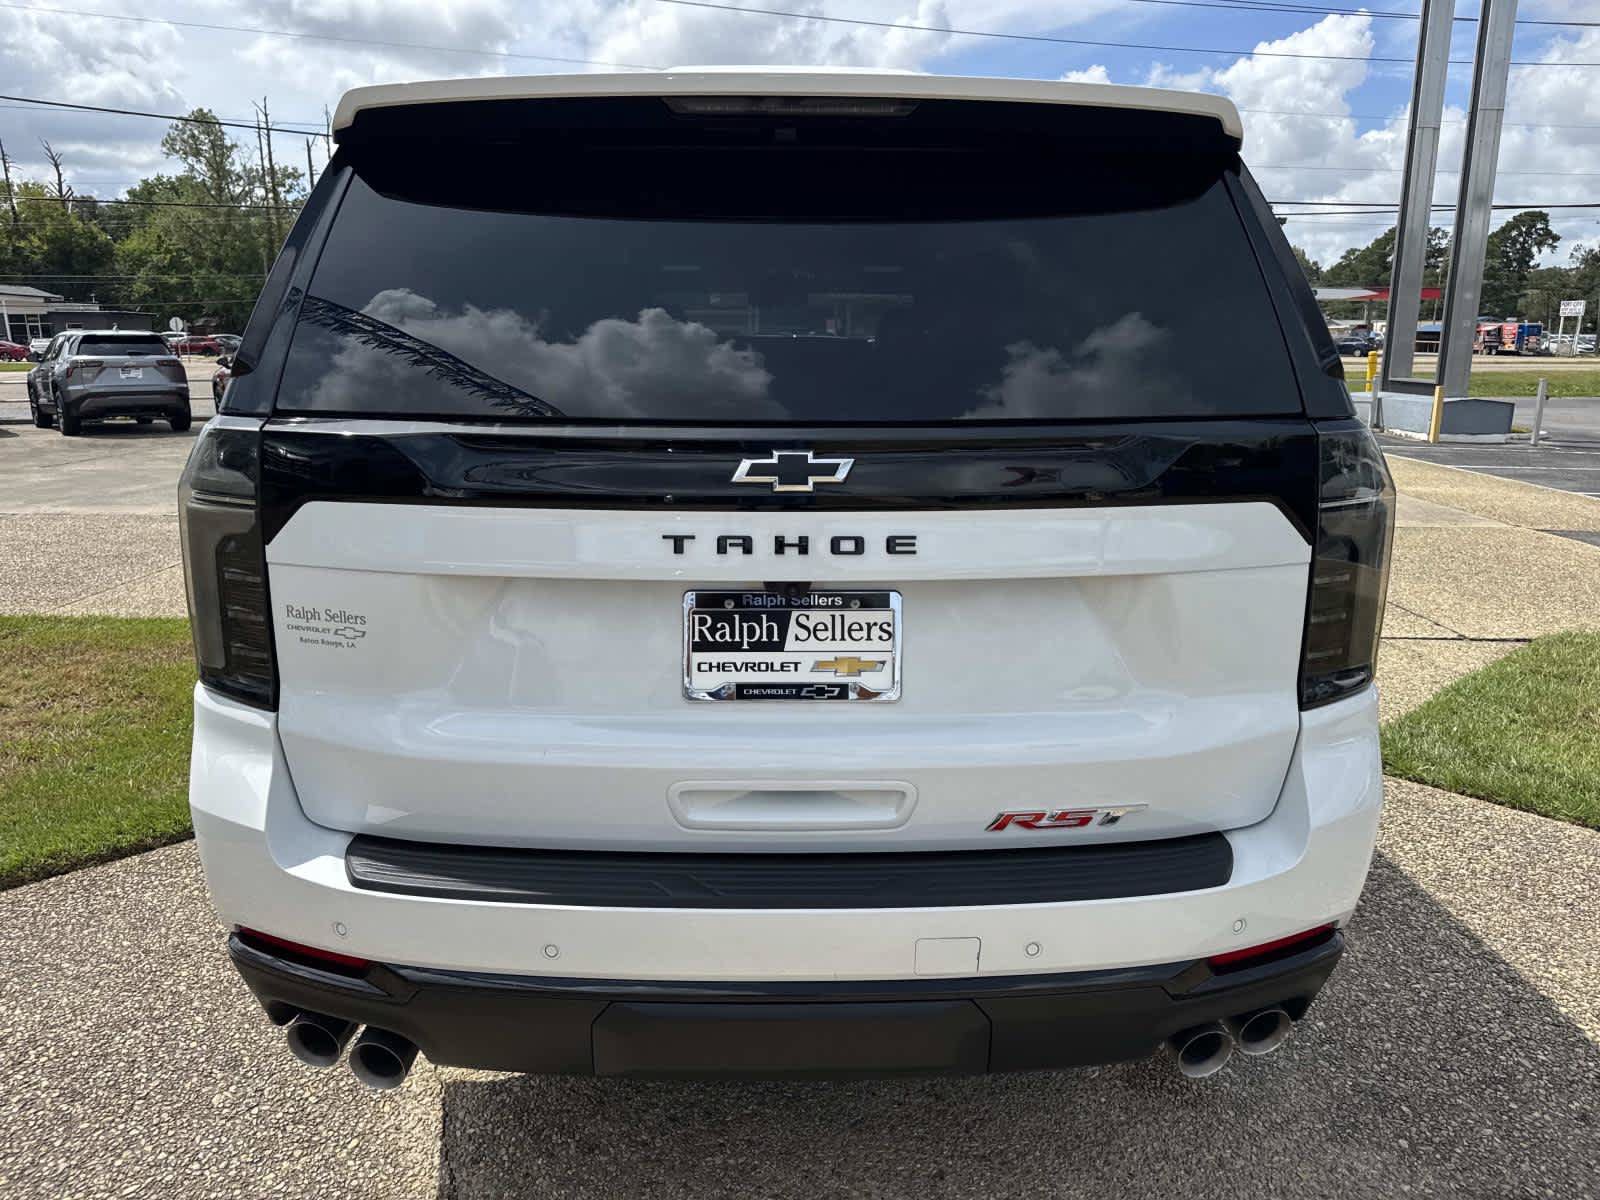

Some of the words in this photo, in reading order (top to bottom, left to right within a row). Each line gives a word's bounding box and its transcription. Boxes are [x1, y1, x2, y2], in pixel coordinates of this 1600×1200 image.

[662, 535, 917, 555] TAHOE
[742, 594, 786, 606] Ralph
[791, 594, 842, 606] Sellers
[286, 605, 320, 623] Ralph
[324, 608, 367, 625] Sellers
[287, 623, 331, 634] CHEVROLET
[692, 614, 780, 649] Ralph
[794, 613, 893, 642] Sellers
[697, 661, 801, 673] CHEVROLET
[984, 803, 1149, 832] RST
